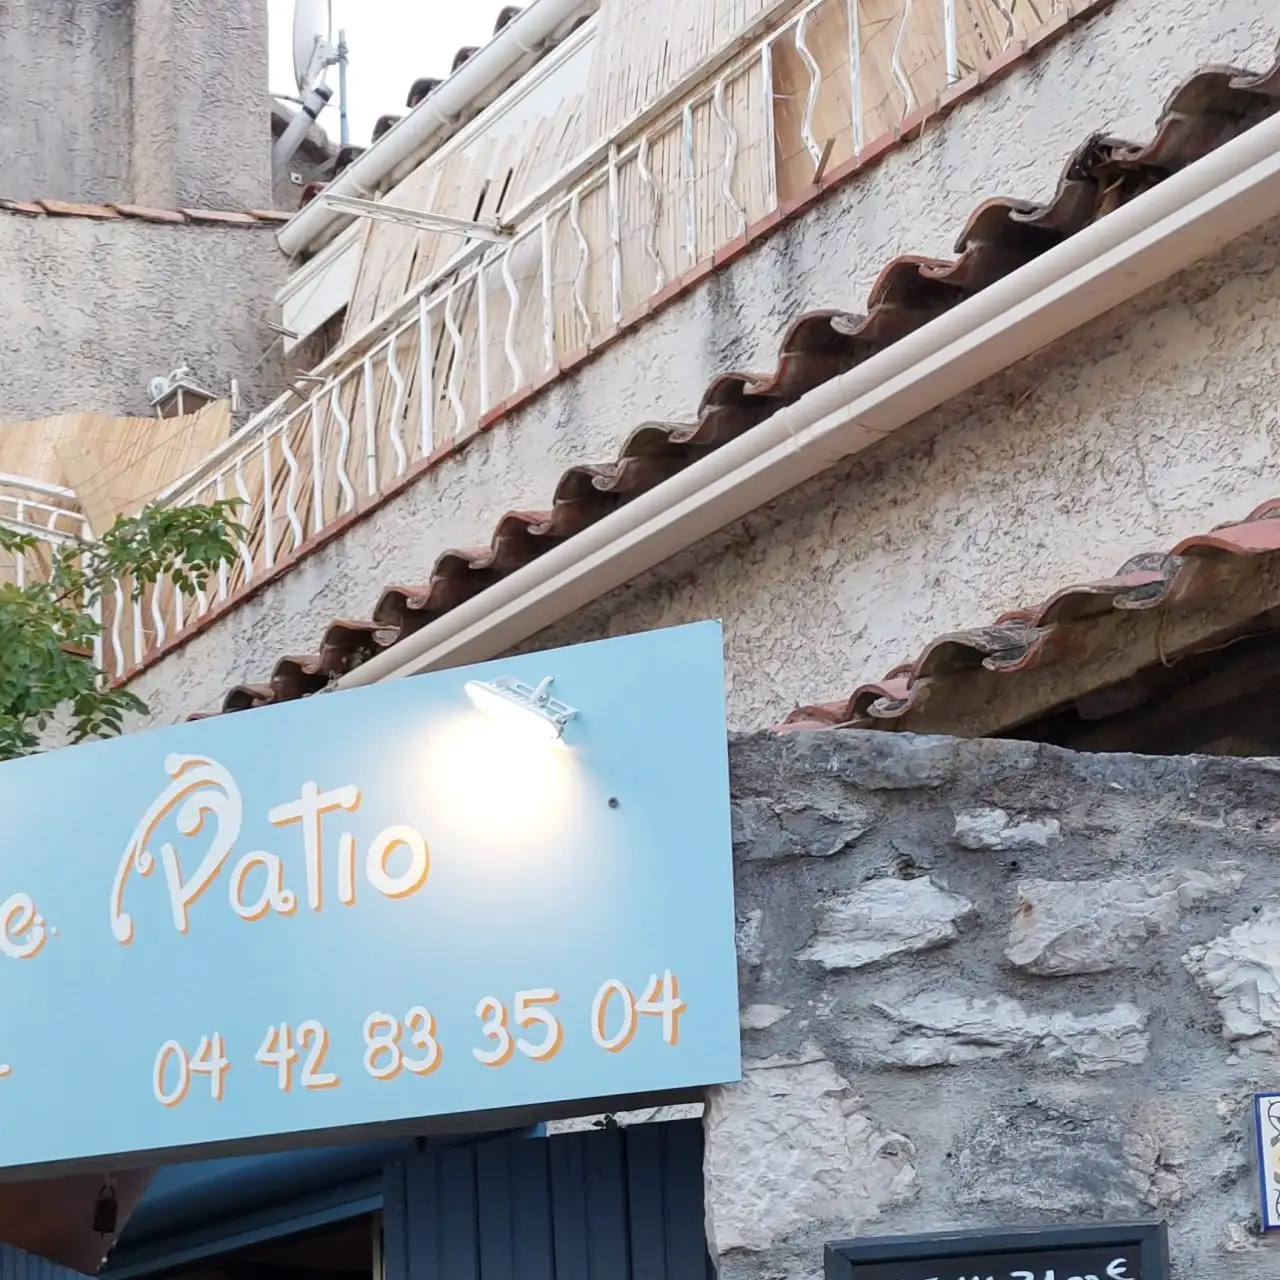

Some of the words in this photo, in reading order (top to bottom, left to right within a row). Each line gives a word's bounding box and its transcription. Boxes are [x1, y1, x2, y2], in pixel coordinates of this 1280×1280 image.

[152, 1031, 231, 1108] 04
[255, 1020, 341, 1092] 42
[363, 1005, 443, 1080] 83
[472, 988, 564, 1068] 35
[591, 969, 687, 1052] 04
